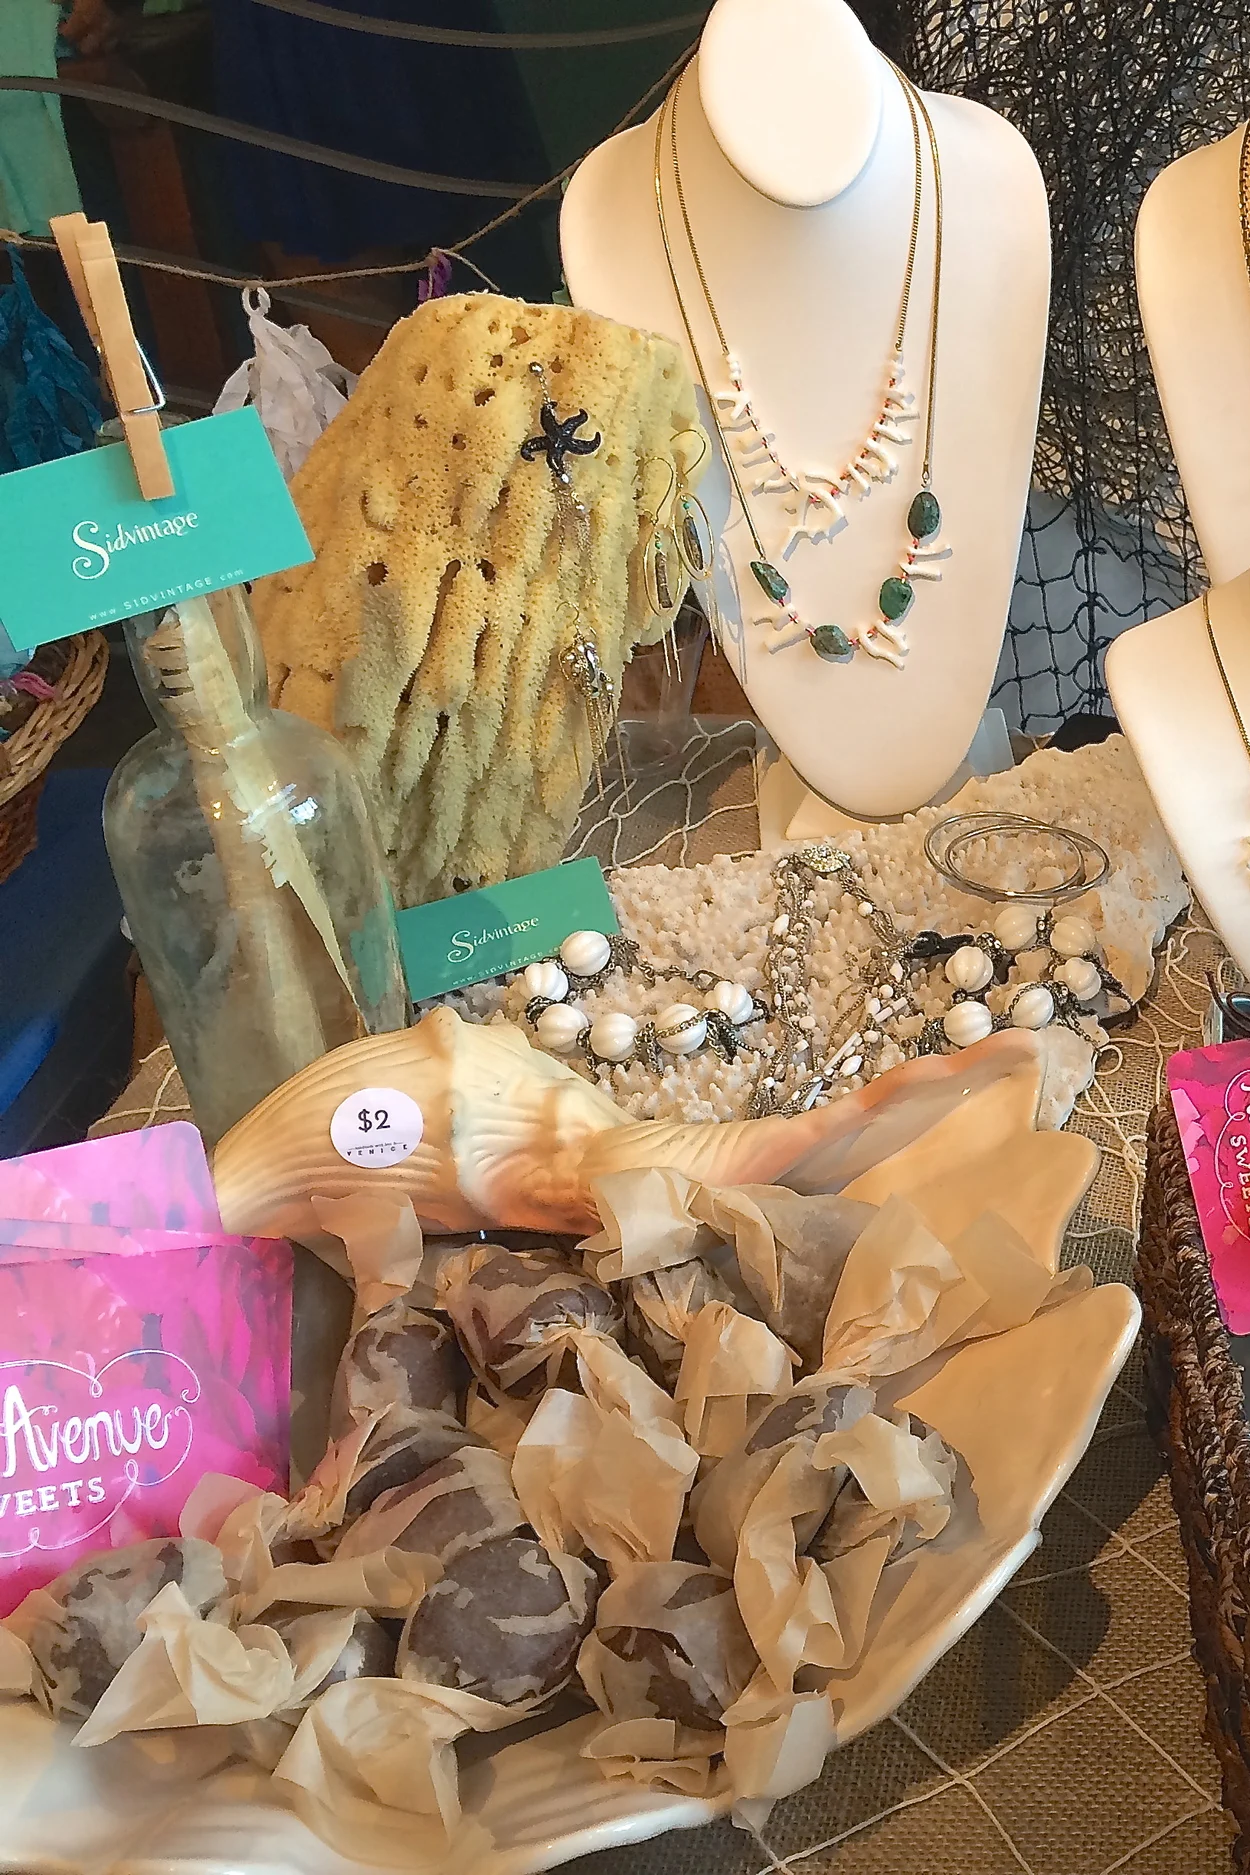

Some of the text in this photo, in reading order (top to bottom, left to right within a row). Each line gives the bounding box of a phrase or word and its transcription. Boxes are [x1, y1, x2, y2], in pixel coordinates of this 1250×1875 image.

[72, 511, 199, 580] Sidvintage
[447, 916, 540, 963] Sidvintage
[357, 1108, 391, 1133] $2
[346, 1144, 408, 1157] VENICE
[0, 1385, 173, 1478] Avenue
